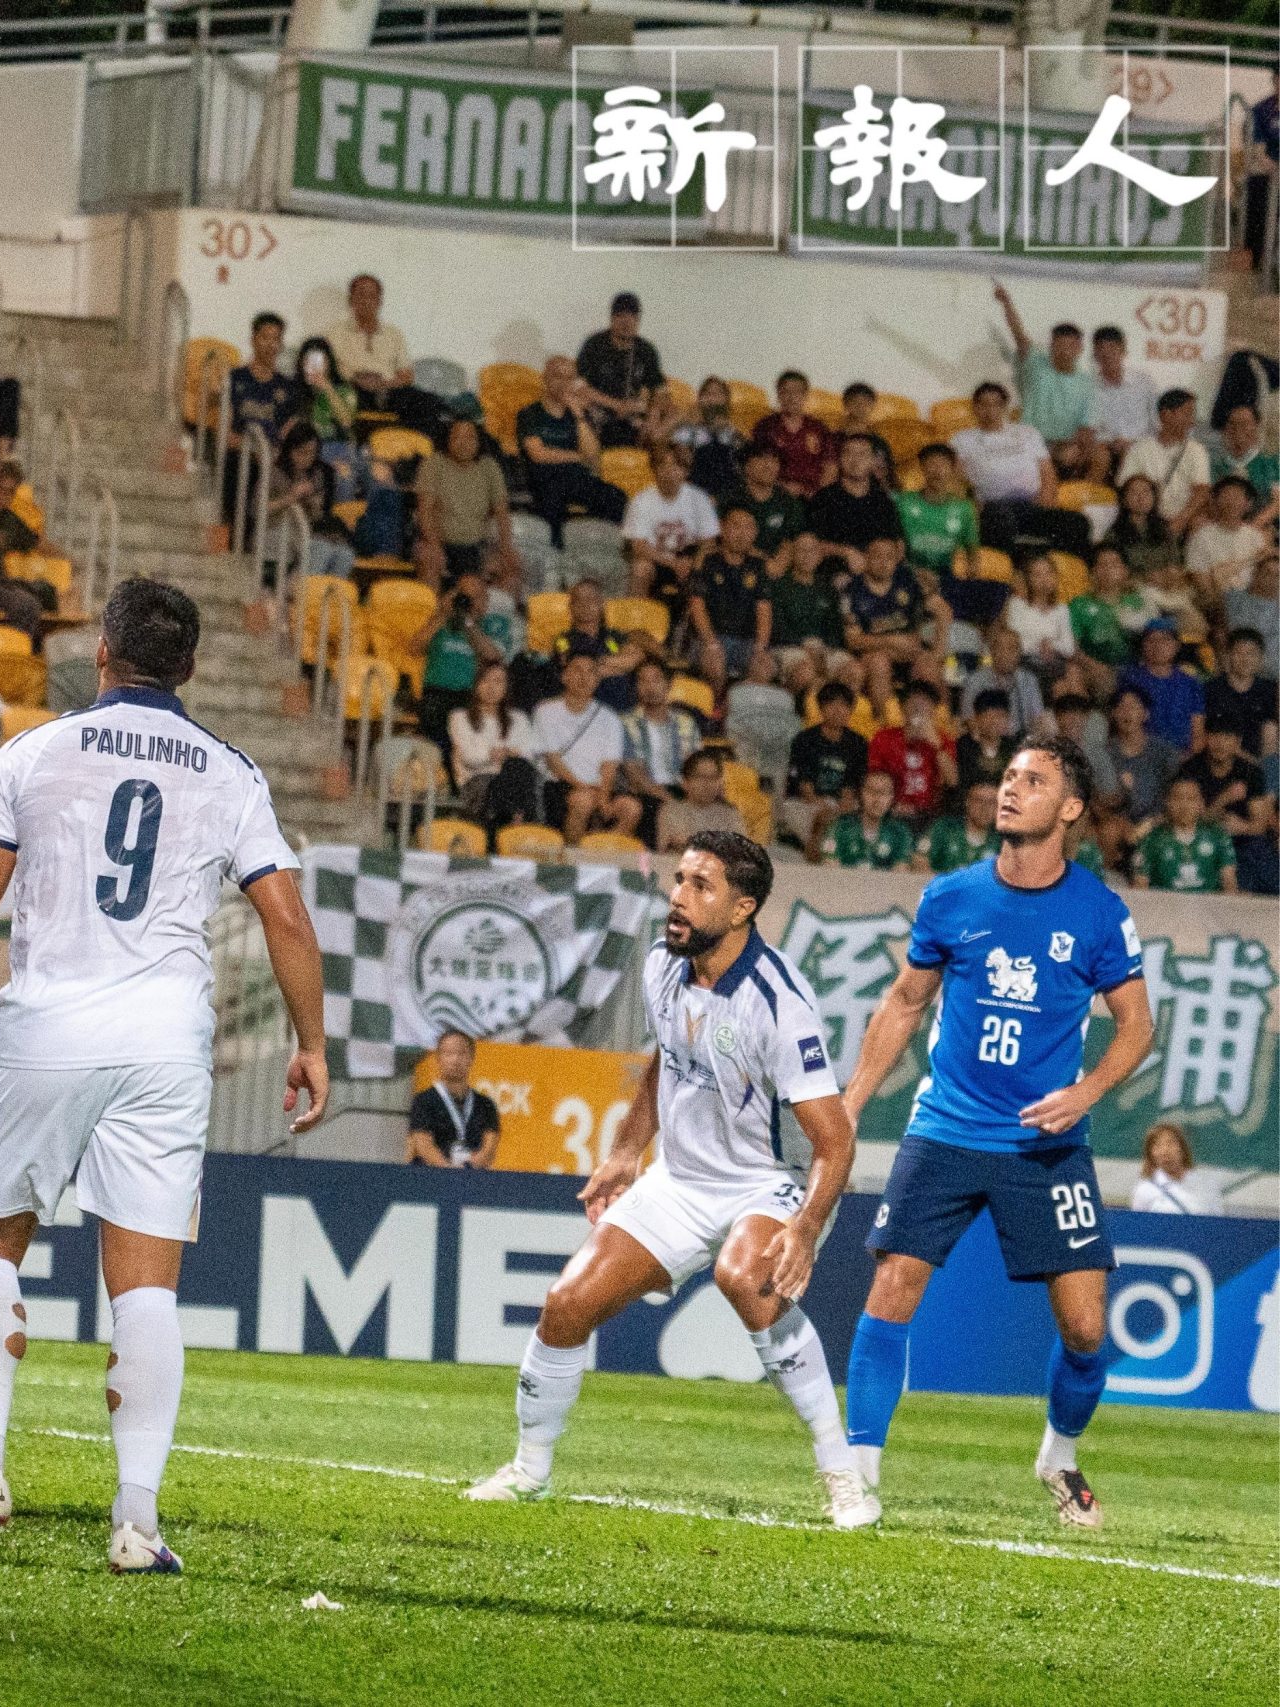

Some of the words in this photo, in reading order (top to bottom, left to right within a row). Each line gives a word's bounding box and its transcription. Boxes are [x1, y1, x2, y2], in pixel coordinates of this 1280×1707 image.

[316, 77, 688, 205] FERNAN
[201, 219, 251, 260] 30
[1159, 298, 1206, 337] 30
[81, 727, 207, 773] PAULINHO
[95, 778, 163, 922] 9
[979, 1014, 1022, 1066] 26
[1052, 1184, 1096, 1230] 26
